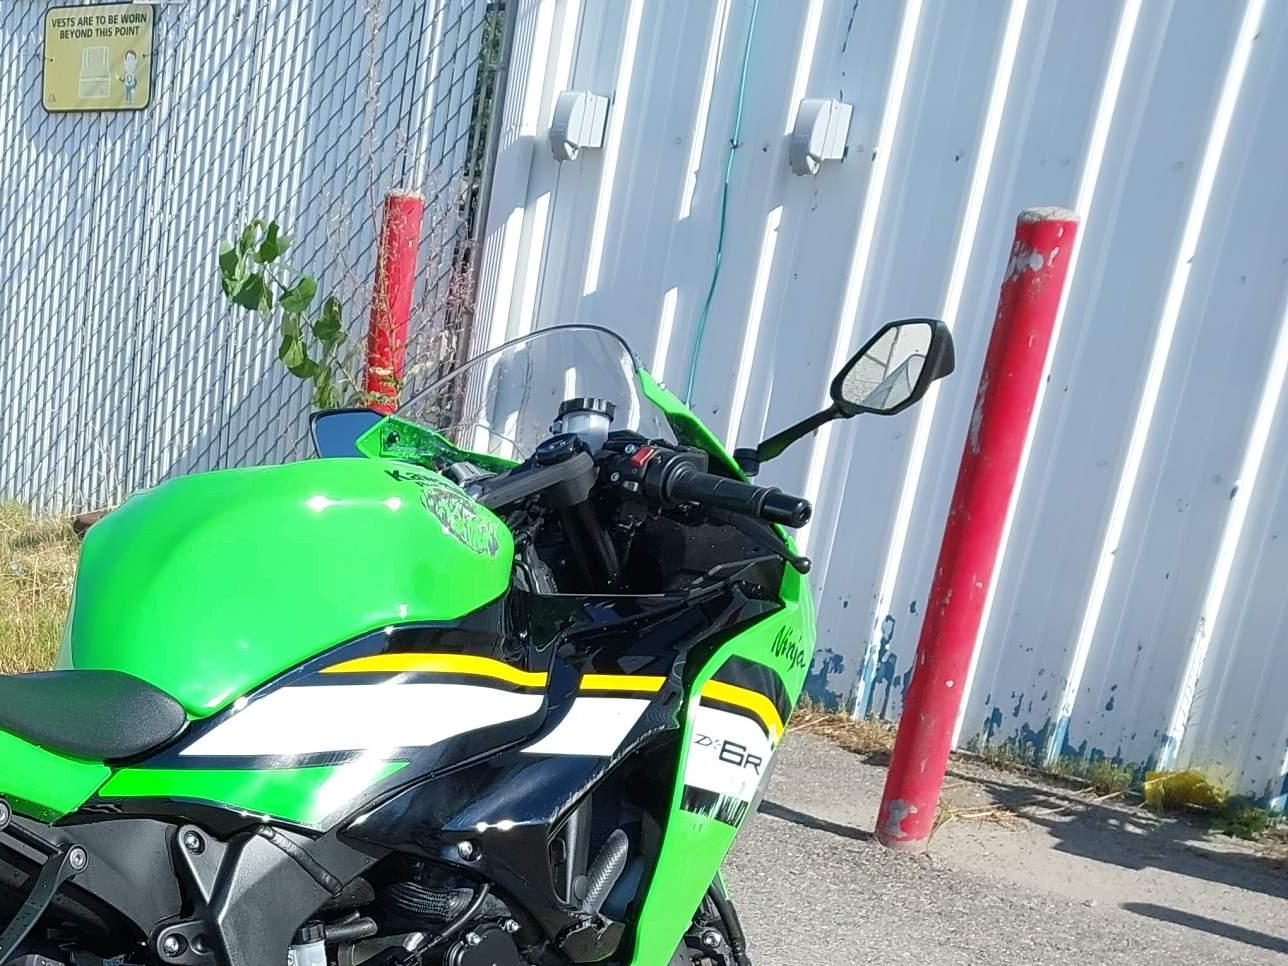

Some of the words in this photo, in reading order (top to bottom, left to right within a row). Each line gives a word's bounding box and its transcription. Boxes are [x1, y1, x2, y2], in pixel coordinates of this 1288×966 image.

[51, 17, 76, 28] VESTS
[77, 16, 93, 27] ARE
[95, 15, 106, 25] TO
[108, 14, 119, 25] BE
[120, 13, 147, 24] WORN
[59, 28, 93, 39] BEYOND
[95, 27, 113, 37] THIS
[114, 25, 140, 37] POINT
[770, 625, 807, 670] Ninja
